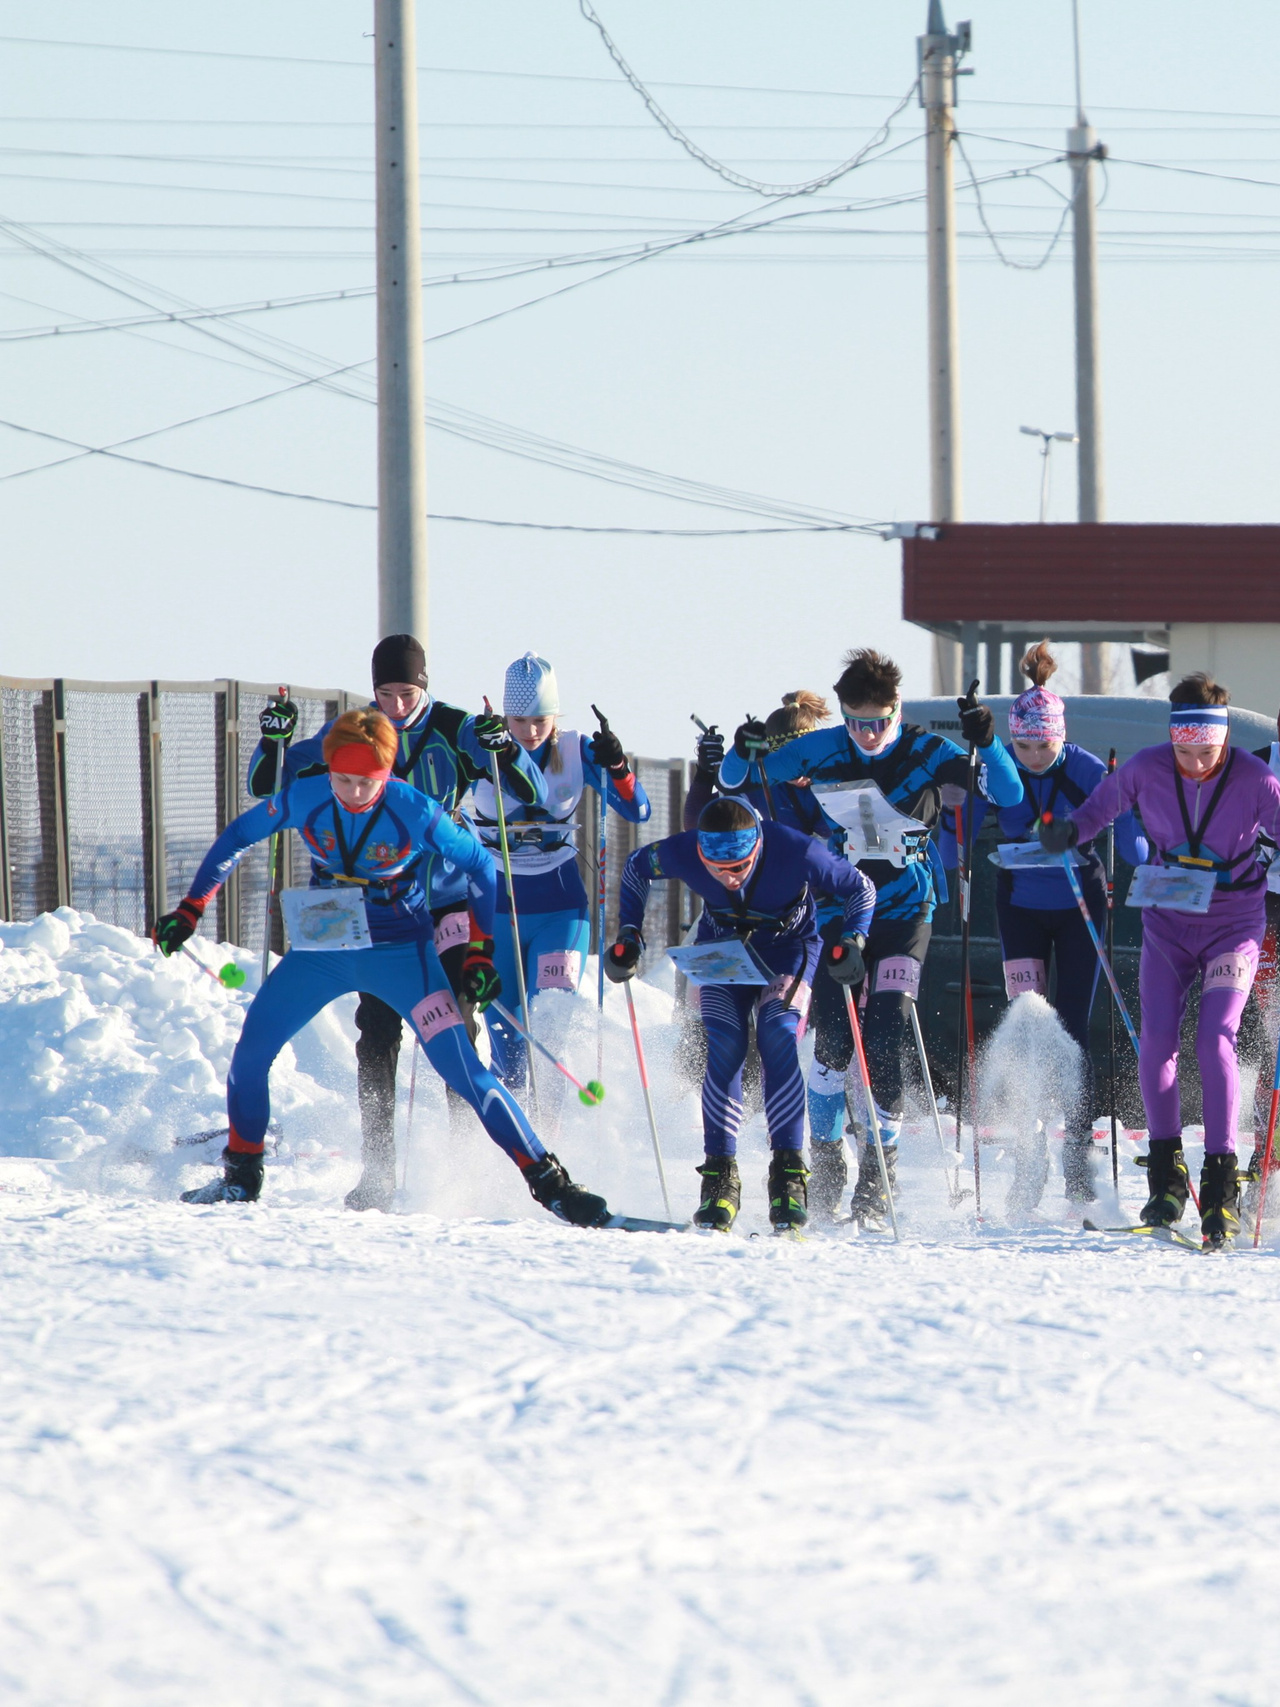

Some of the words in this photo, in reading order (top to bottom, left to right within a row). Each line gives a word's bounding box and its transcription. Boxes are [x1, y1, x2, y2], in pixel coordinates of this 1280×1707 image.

[930, 720, 964, 730] THUL
[1010, 972, 1041, 985] 503.1
[421, 1001, 454, 1028] 401.1
